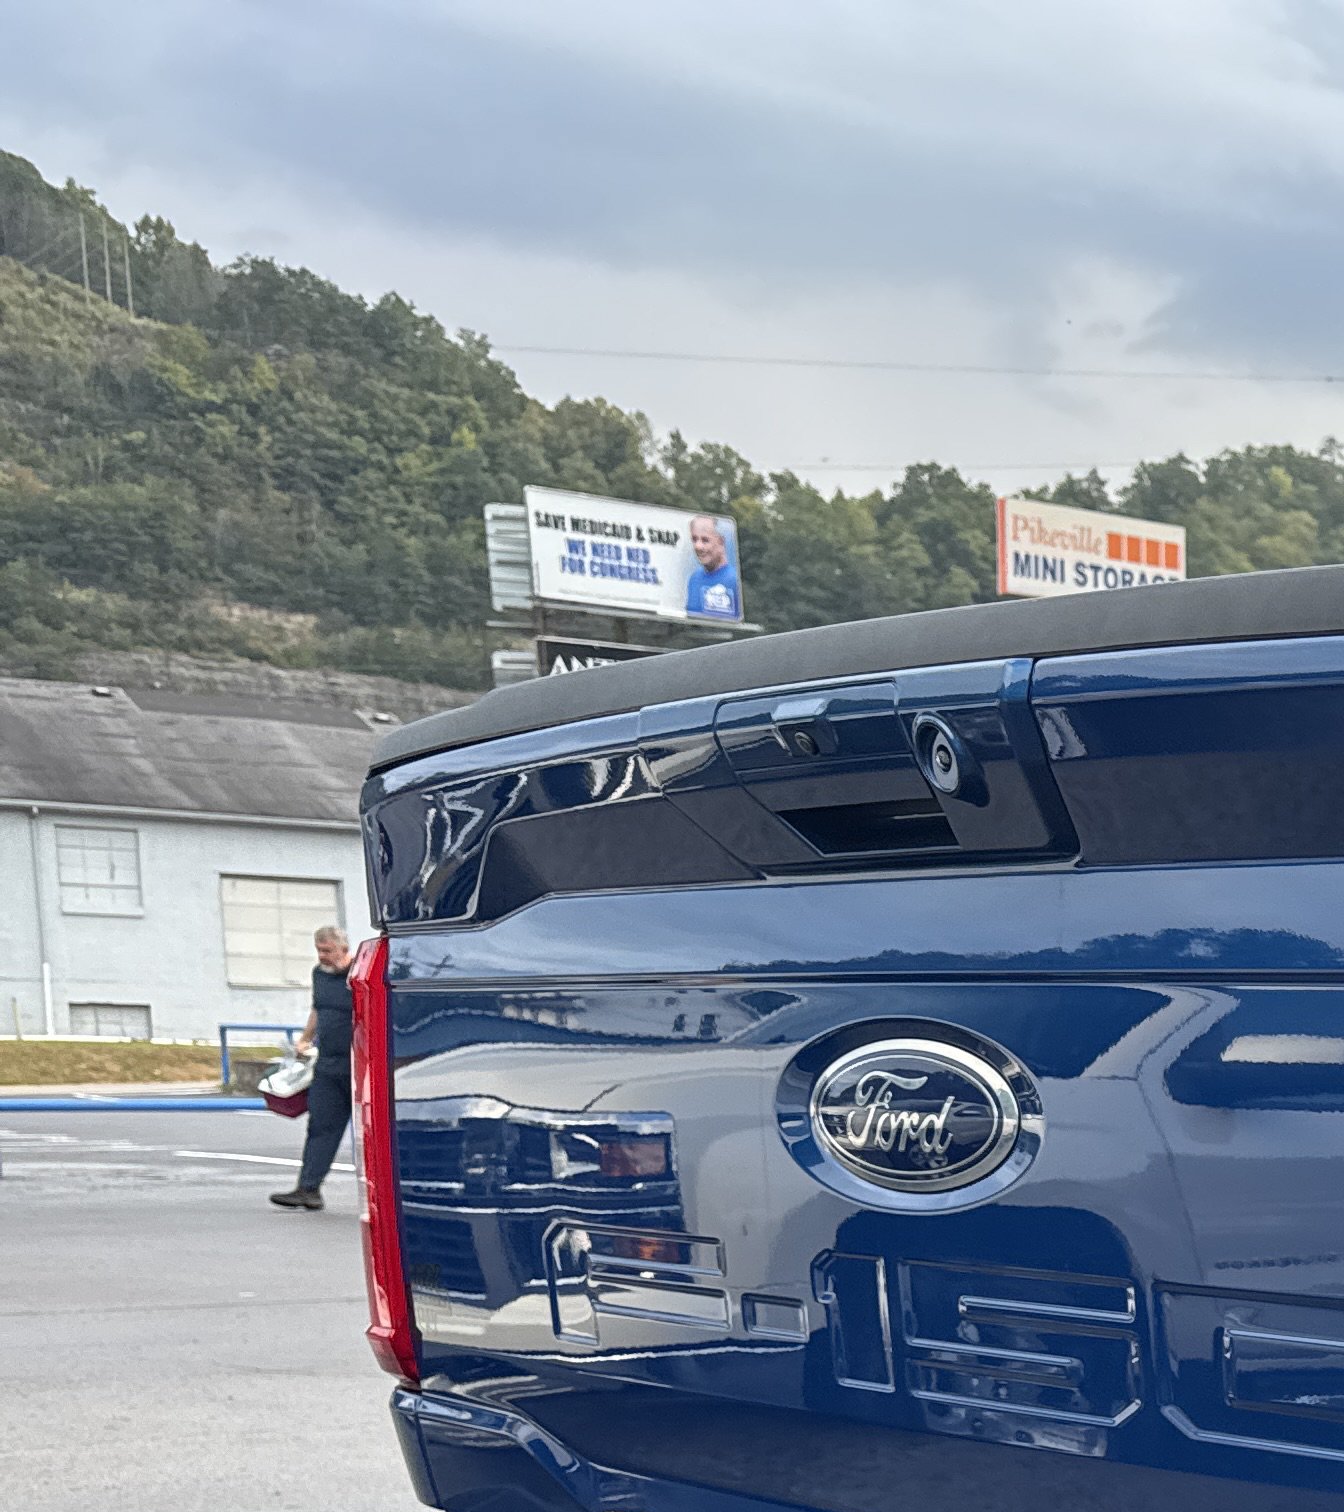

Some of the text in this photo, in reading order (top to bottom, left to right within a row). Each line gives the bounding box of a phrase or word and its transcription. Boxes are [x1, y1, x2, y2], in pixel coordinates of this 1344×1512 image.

[534, 510, 566, 532] SAVE
[570, 516, 631, 539] MEDICAID
[648, 526, 681, 547] SNAP
[1011, 514, 1102, 553] Pikeville
[560, 554, 587, 575] FOR
[566, 537, 587, 557] WE
[590, 540, 623, 561] NEED
[1013, 550, 1180, 589] MINI STORA
[846, 1070, 955, 1153] Ford
